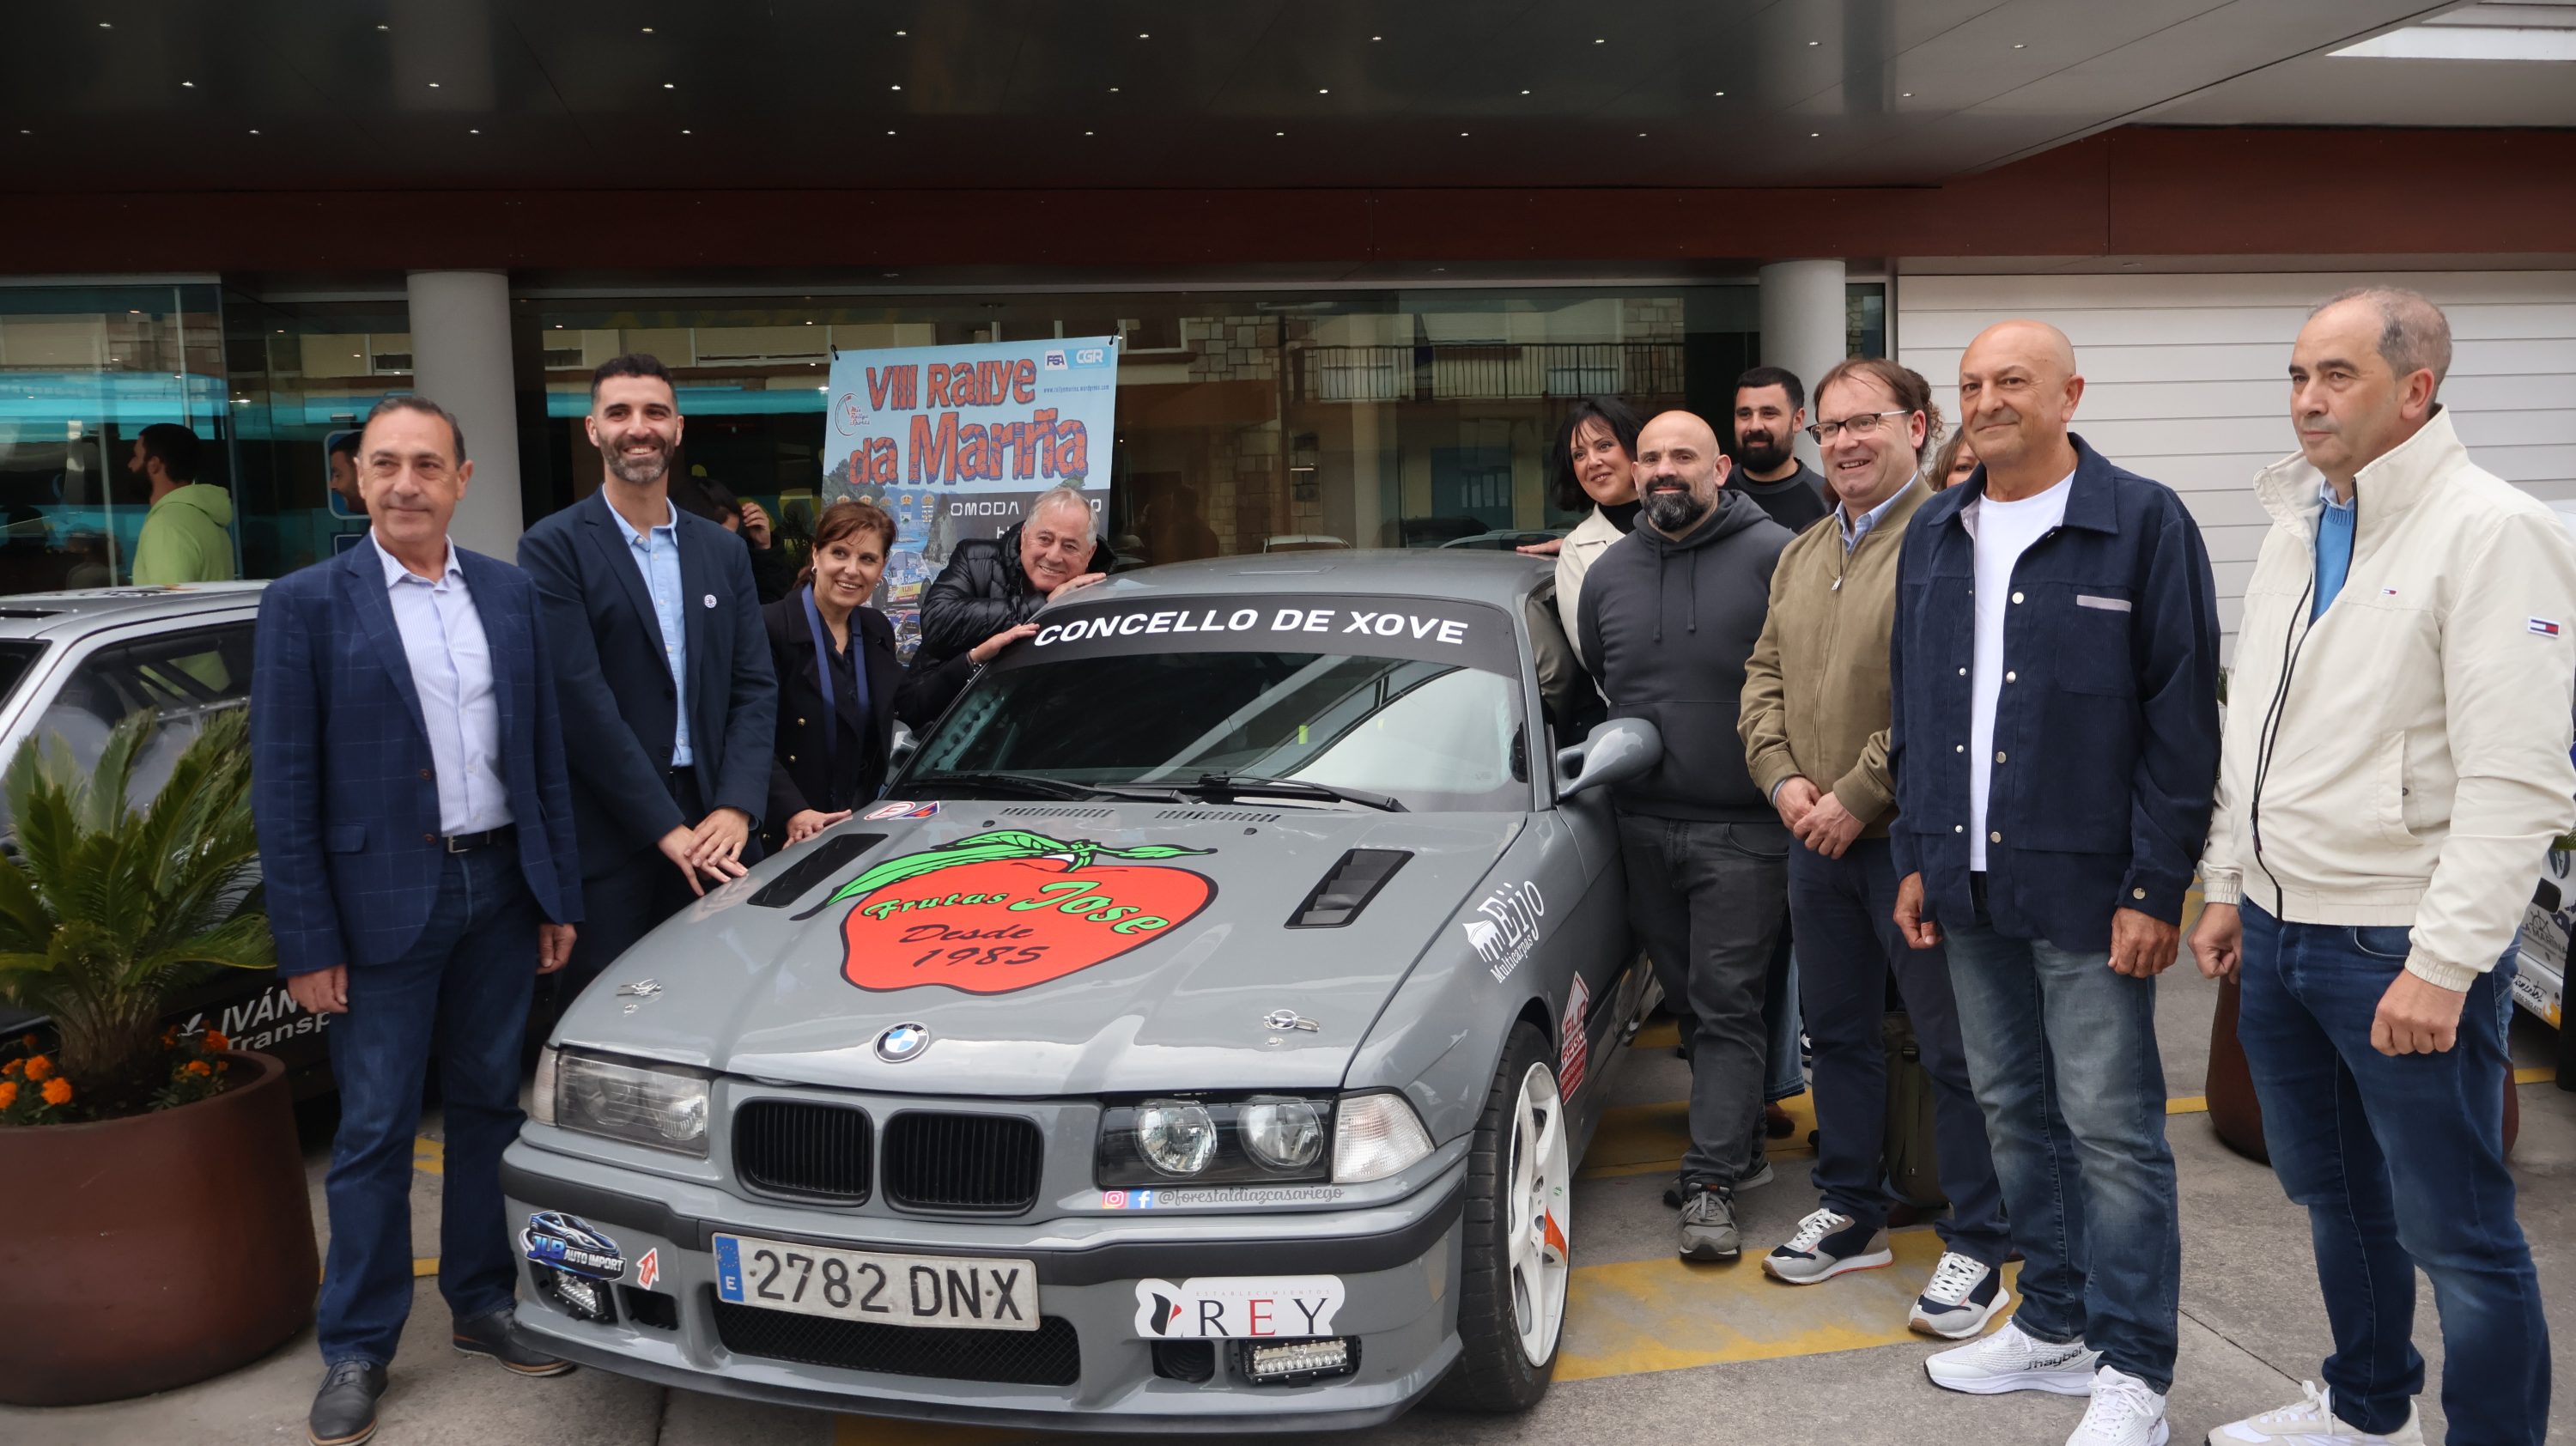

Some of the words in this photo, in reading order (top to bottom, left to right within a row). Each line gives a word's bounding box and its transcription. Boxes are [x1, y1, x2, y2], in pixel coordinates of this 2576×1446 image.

[1076, 349, 1103, 364] CGR
[866, 364, 918, 411] VIII
[927, 359, 1036, 409] Rallye
[849, 436, 898, 485] da
[908, 408, 1088, 485] Mariña
[951, 501, 1019, 516] OMODA
[1034, 609, 1259, 647] CONCELLO
[1271, 610, 1335, 632] DE
[1343, 611, 1470, 645] XOVE
[861, 893, 1009, 920] Frutas
[1006, 881, 1170, 934] Jose
[1477, 880, 1544, 948] Eijo
[899, 924, 1034, 943] Desde
[913, 946, 1050, 968] 1985
[1490, 934, 1534, 984] Multicarpas
[1159, 1186, 1345, 1206] @forestaldiazcasariego
[563, 1249, 589, 1265] AUTO
[588, 1253, 624, 1272] IMPORT
[726, 1275, 738, 1291] E
[754, 1249, 890, 1313] 2782
[909, 1264, 1023, 1321] DNX
[1197, 1297, 1329, 1337] REY
[2023, 1345, 2085, 1371] Jhayber
